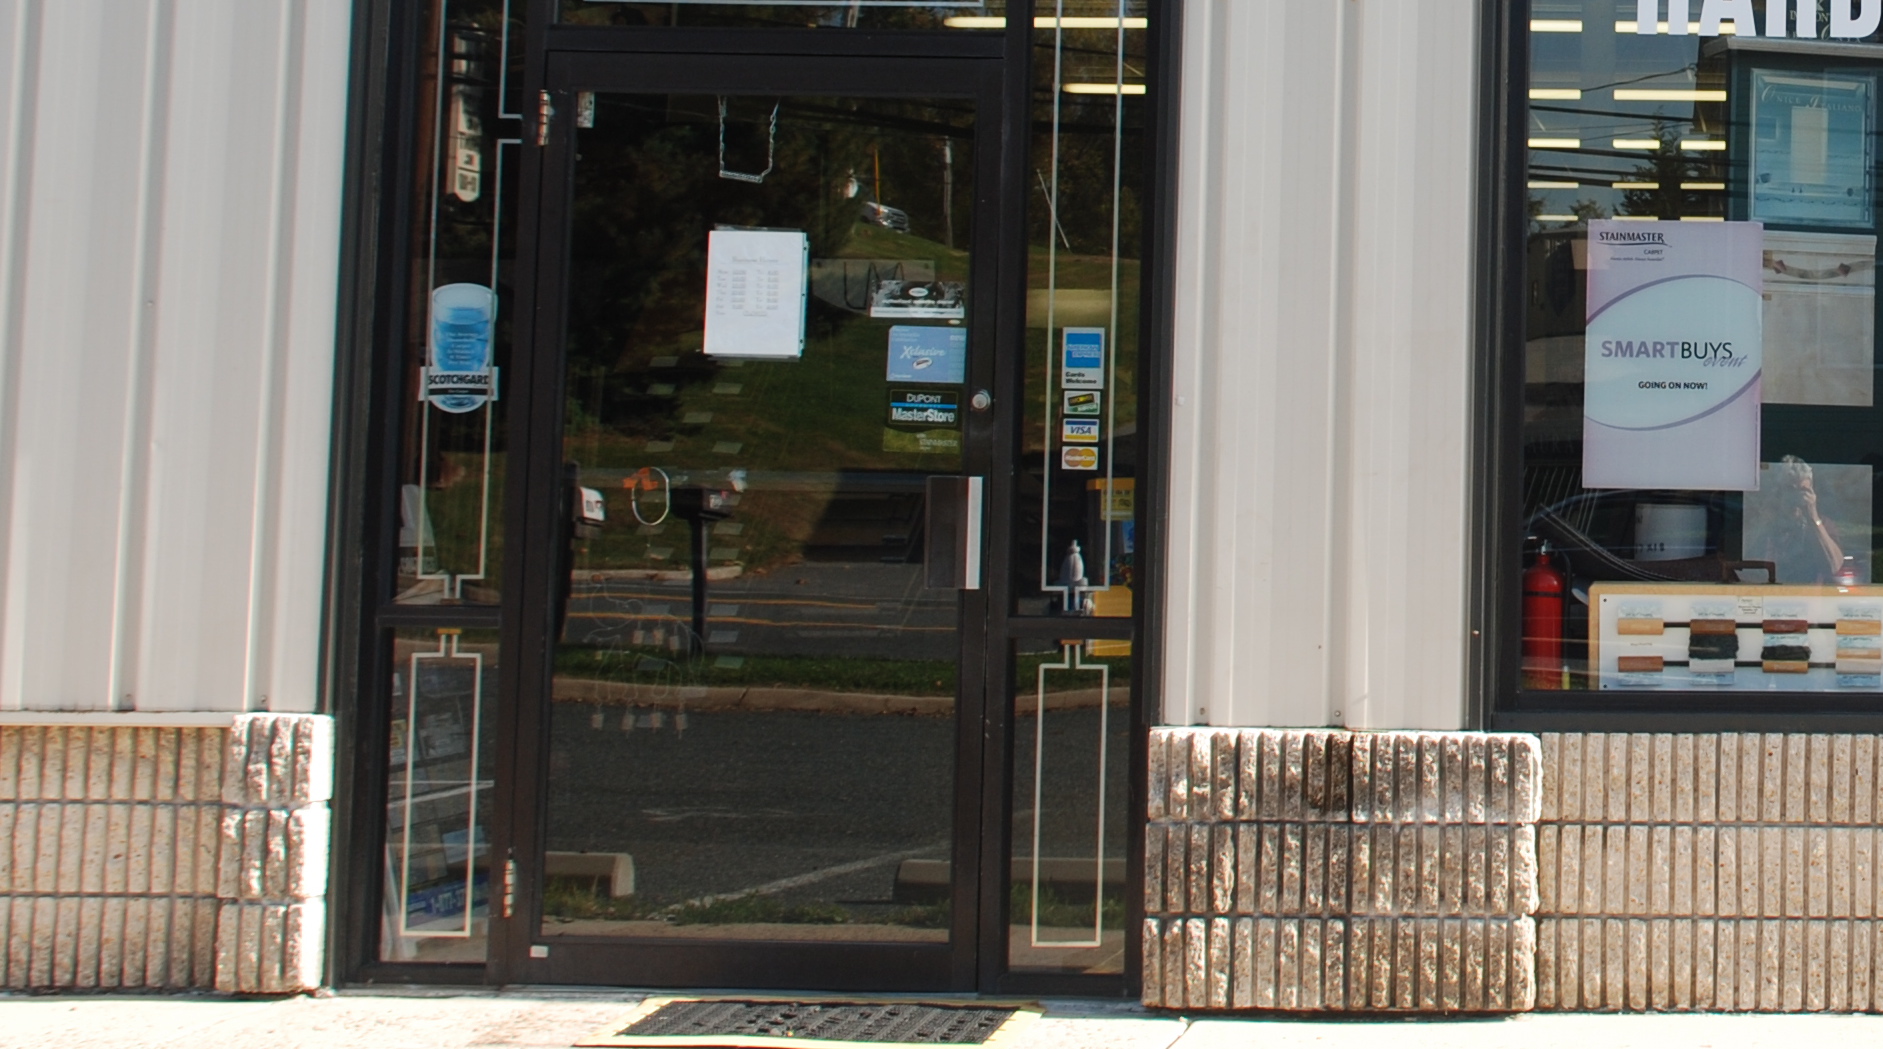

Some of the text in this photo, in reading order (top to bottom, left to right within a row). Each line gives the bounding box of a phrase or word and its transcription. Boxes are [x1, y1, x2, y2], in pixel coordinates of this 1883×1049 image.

[1599, 232, 1666, 244] STAINMASTER
[1601, 341, 1733, 359] SMARTBUYS
[1703, 354, 1748, 368] event
[1638, 381, 1708, 390] GOING ON NOW!
[892, 407, 955, 422] MasterStore
[1070, 426, 1092, 435] VISA
